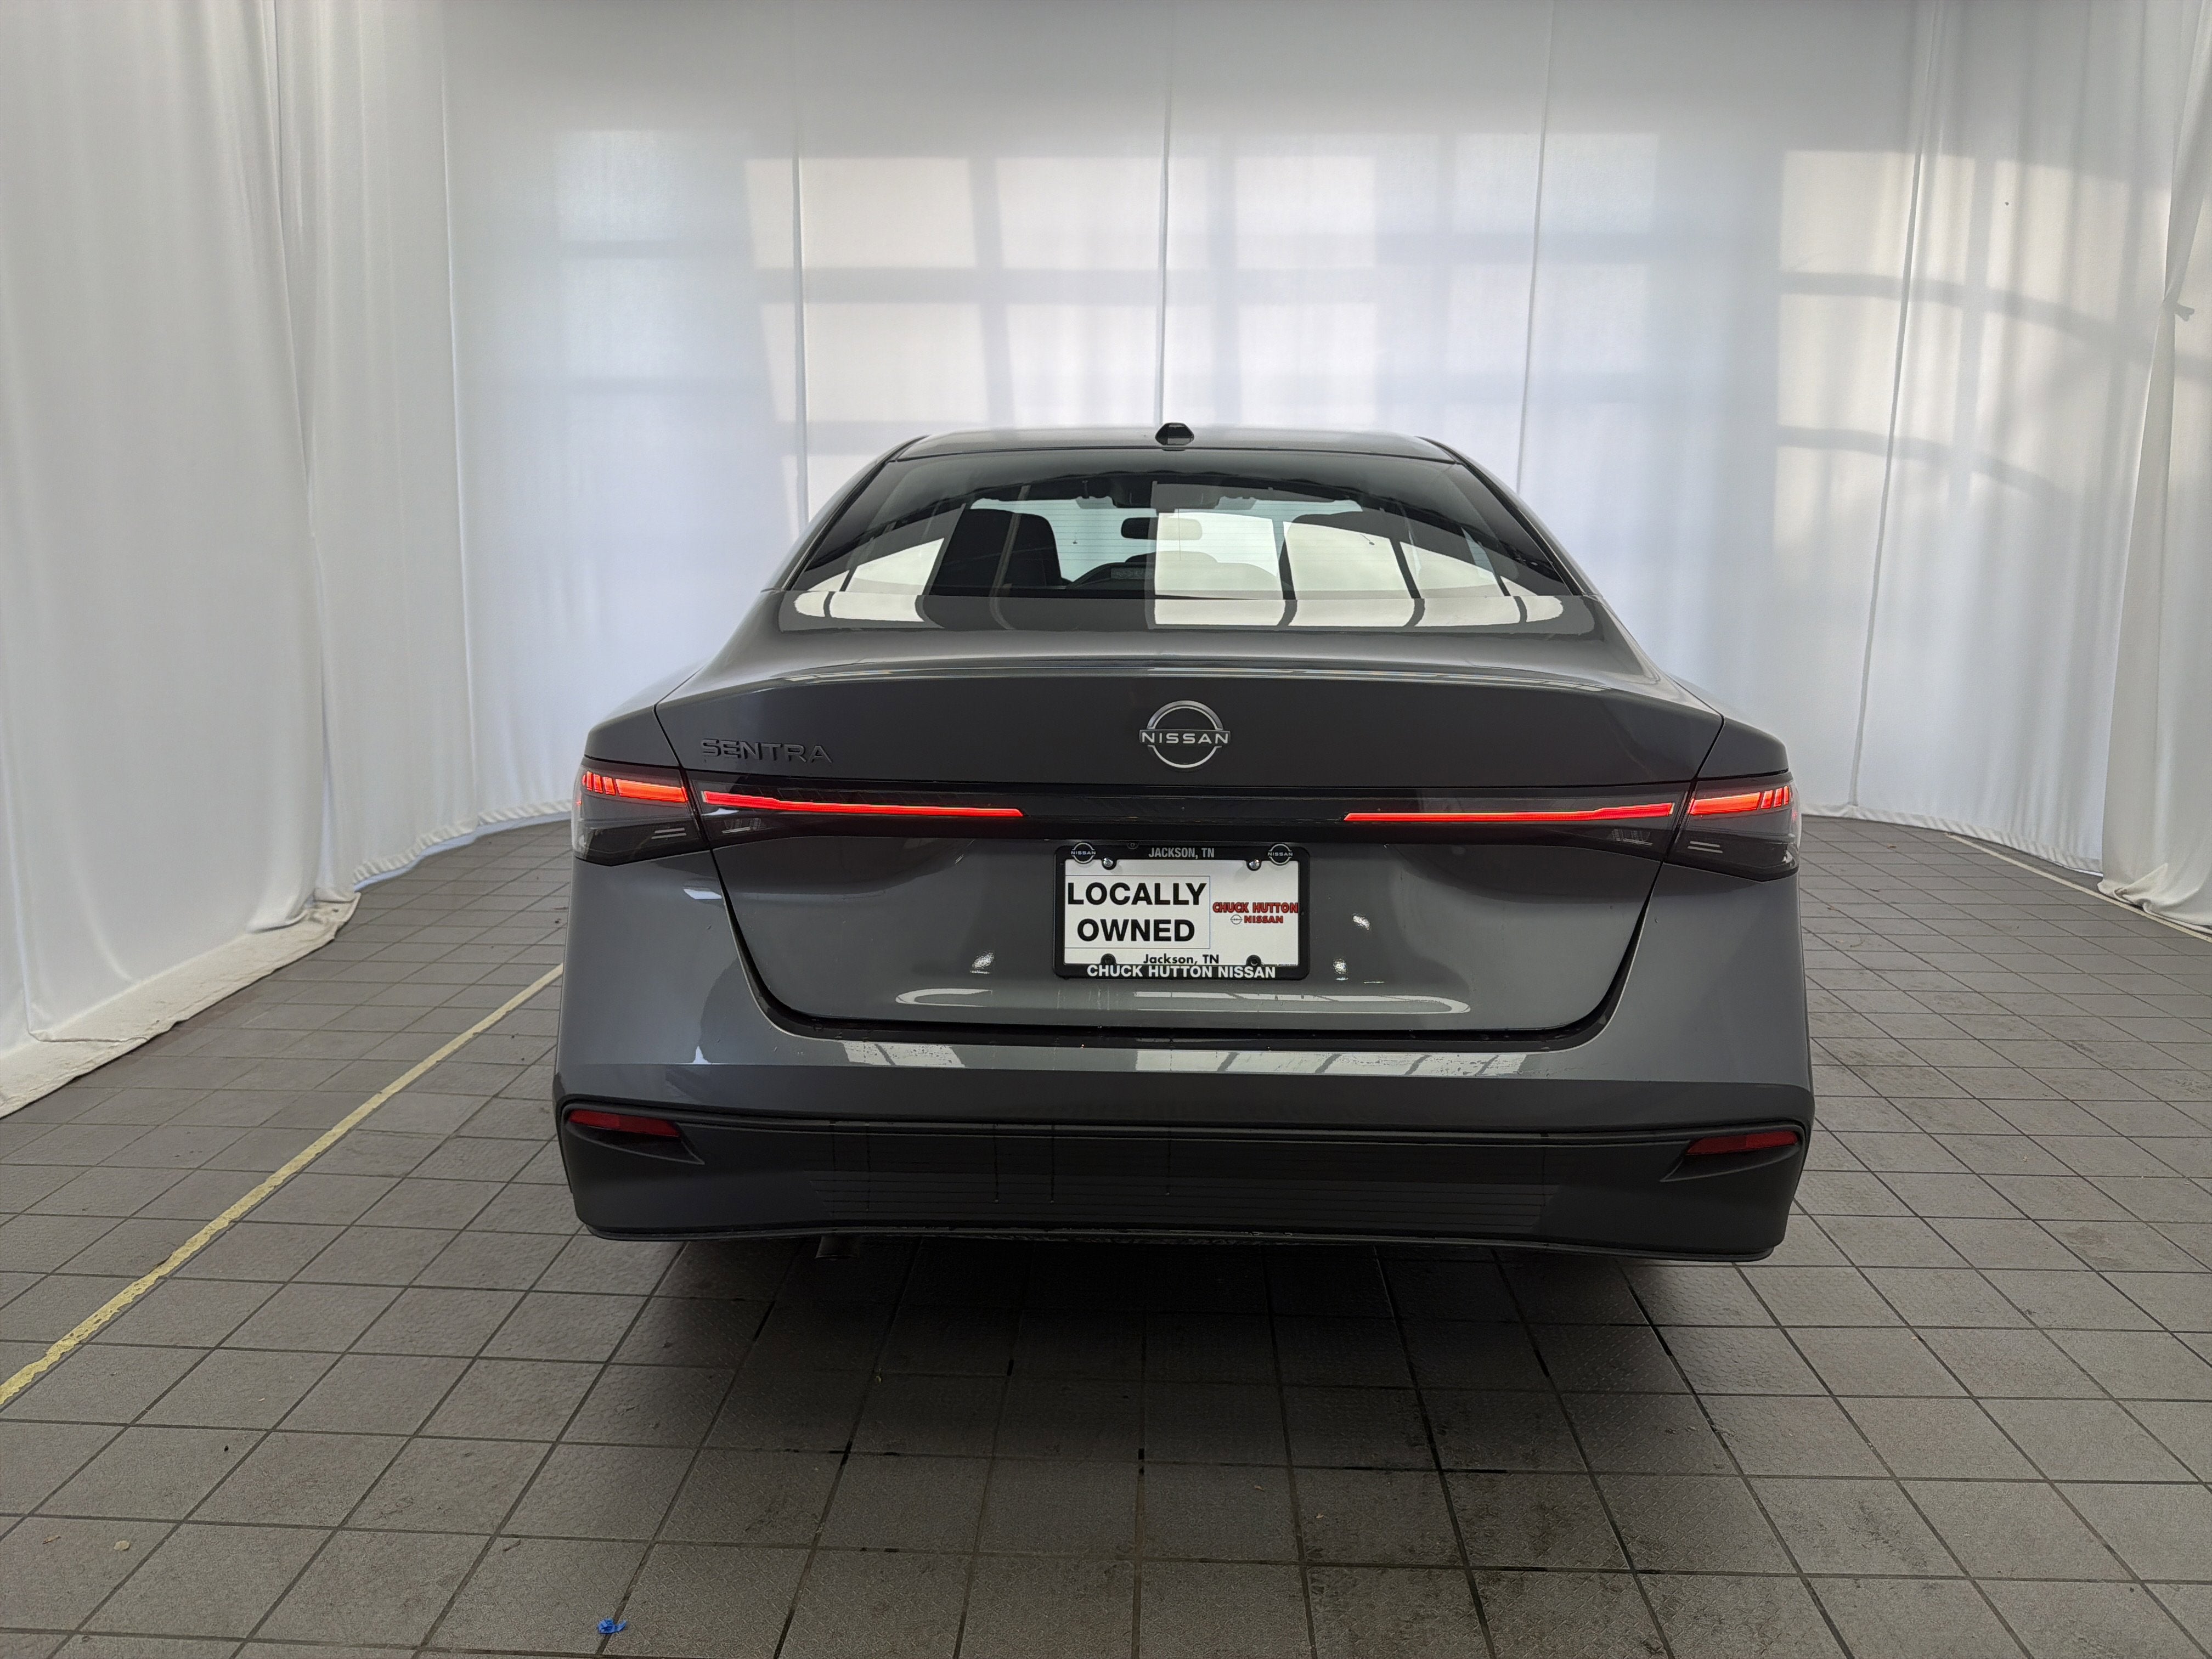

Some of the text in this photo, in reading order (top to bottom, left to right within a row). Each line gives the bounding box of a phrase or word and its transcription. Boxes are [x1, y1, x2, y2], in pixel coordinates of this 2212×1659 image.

[1142, 732, 1228, 744] NISSAN
[700, 738, 833, 763] SENTRA
[1148, 848, 1215, 860] JACKSON, TN
[1068, 882, 1207, 906] LOCALLY
[1212, 902, 1299, 913] CHUCK HUTTON
[1244, 916, 1284, 924] NISSAN
[1077, 918, 1195, 942] OWNED
[1143, 953, 1220, 966] Jackson, TN
[1087, 965, 1276, 978] CHUCK HUTTON NISSAN
